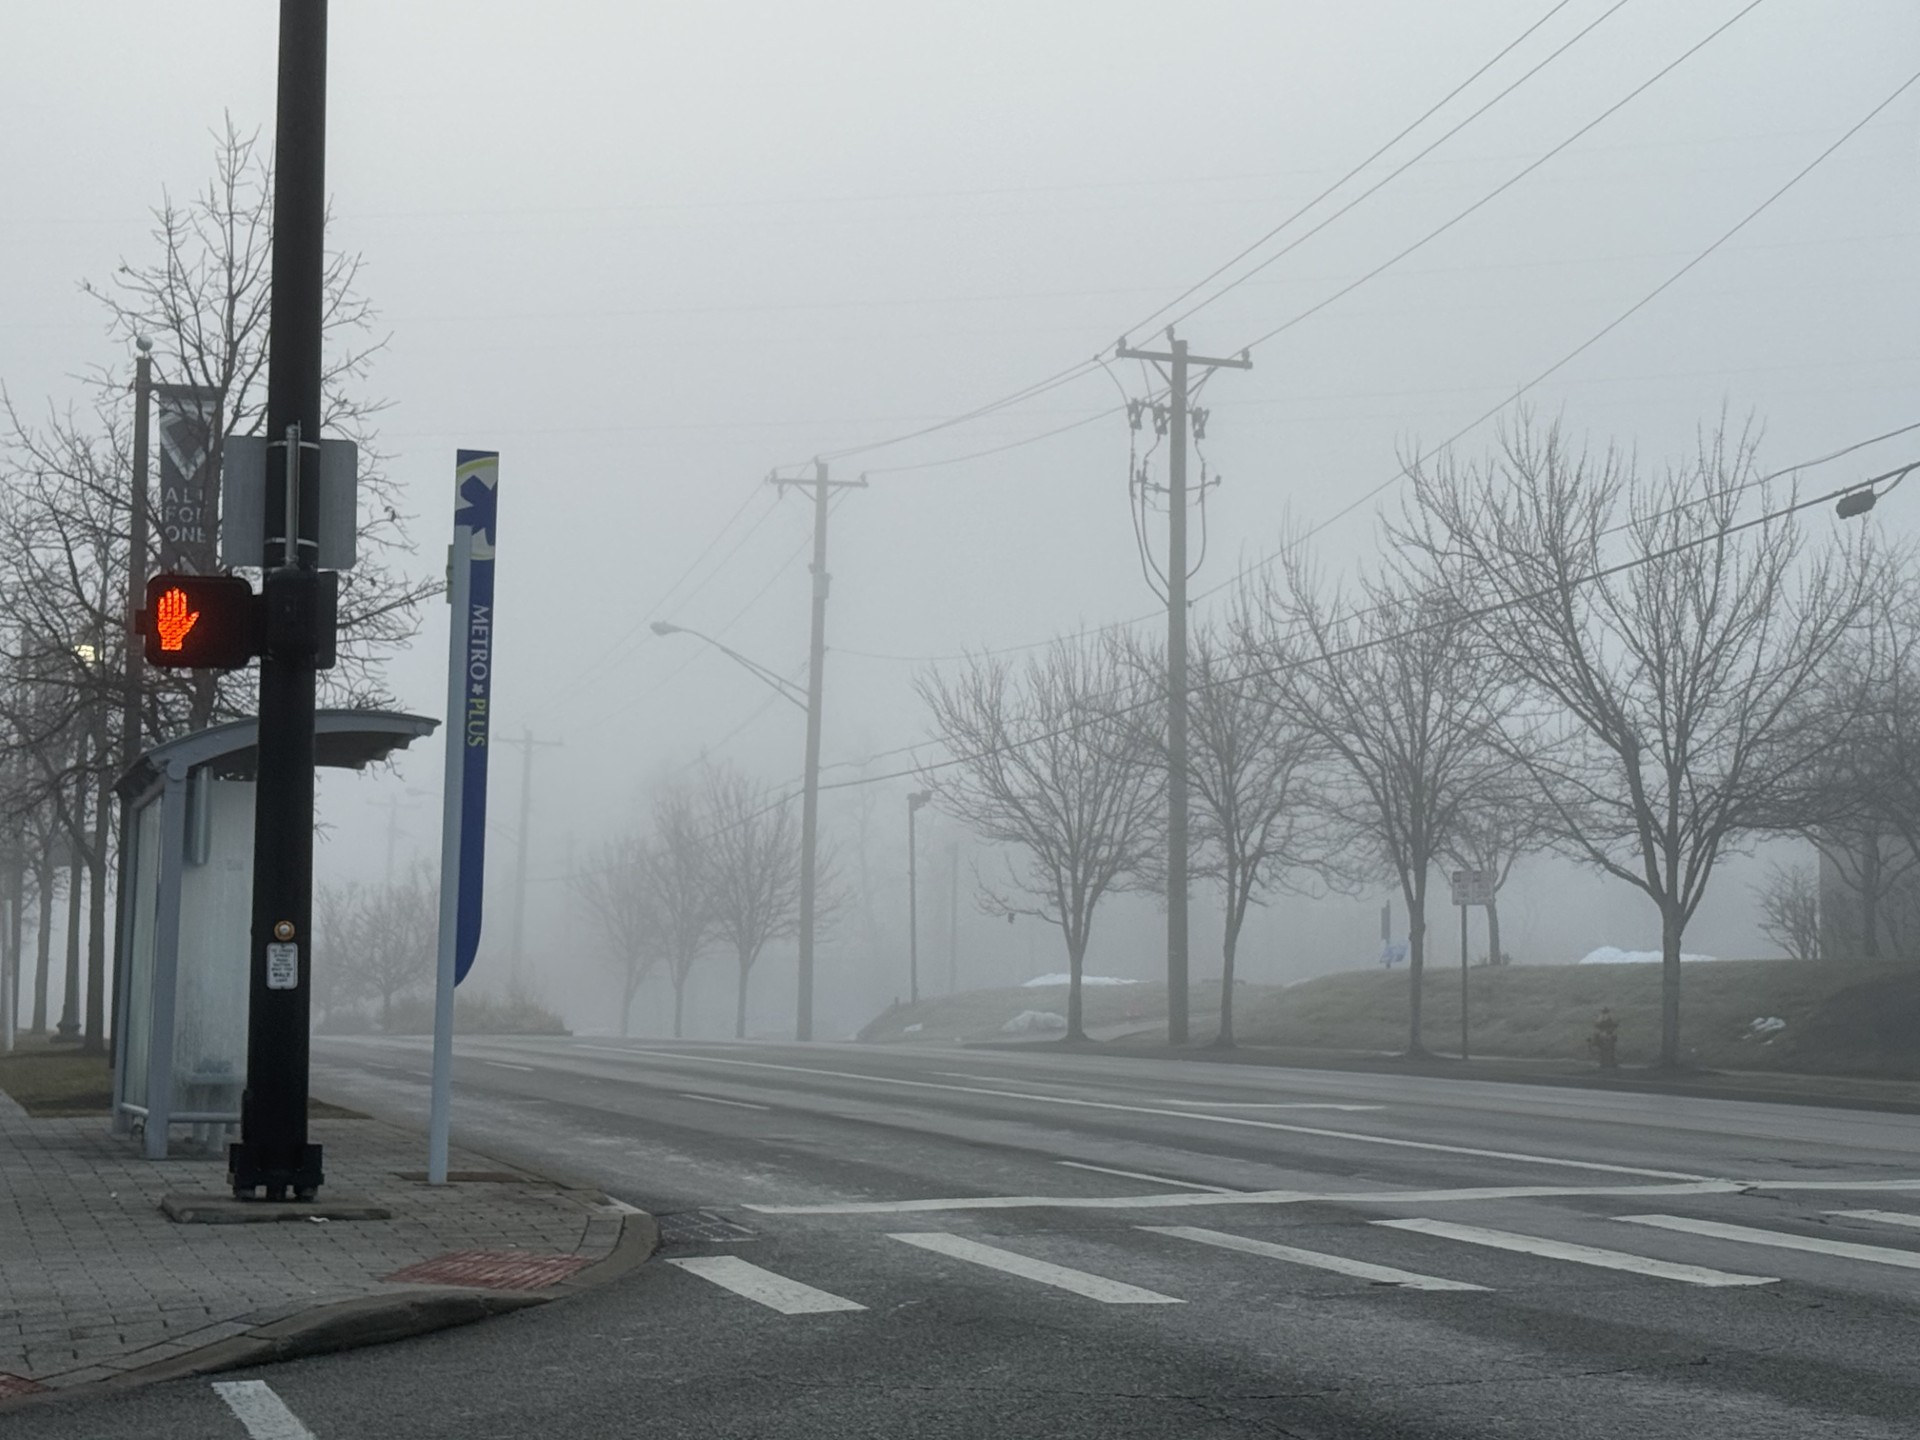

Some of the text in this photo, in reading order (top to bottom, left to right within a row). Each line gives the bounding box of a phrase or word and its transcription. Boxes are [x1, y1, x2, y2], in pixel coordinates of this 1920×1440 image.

[165, 525, 207, 543] ONE
[467, 604, 489, 747] METRO PLUS
